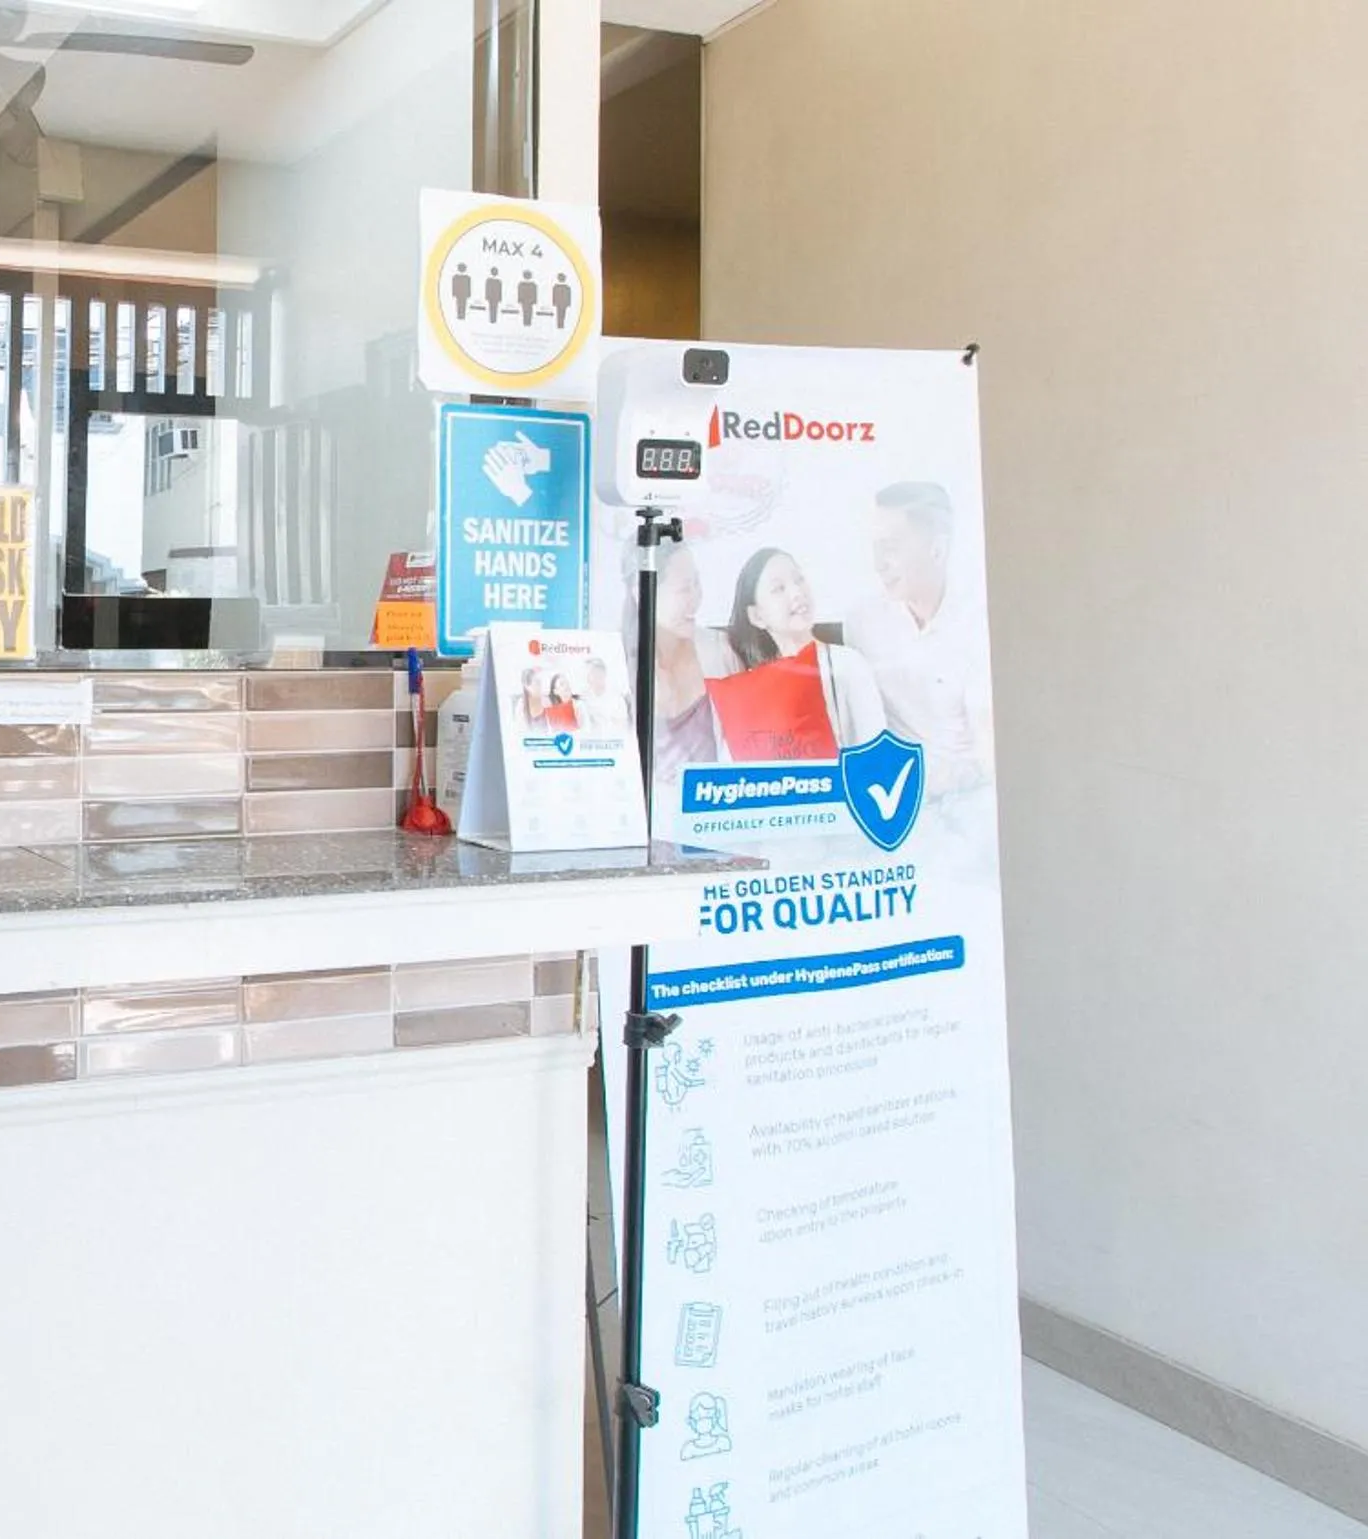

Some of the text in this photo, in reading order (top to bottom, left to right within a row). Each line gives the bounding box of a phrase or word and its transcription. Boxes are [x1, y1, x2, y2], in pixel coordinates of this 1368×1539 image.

[481, 237, 544, 258] MAX 4
[722, 411, 876, 442] RedDoorz
[463, 516, 570, 547] SANITIZE
[474, 550, 557, 579] HANDS
[484, 581, 548, 611] HERE
[695, 775, 833, 804] HygienePass
[692, 812, 837, 834] OFFICIALLY CERTIFIED
[703, 863, 917, 900] HE GOLDEN STANDARD
[773, 883, 918, 930] QUALITY
[651, 948, 955, 999] The checklist under HygienePass certification:
[788, 1027, 803, 1041] of
[745, 1047, 806, 1069] products
[809, 1043, 834, 1059] and
[748, 1117, 821, 1139] Availability
[751, 1141, 782, 1158] with
